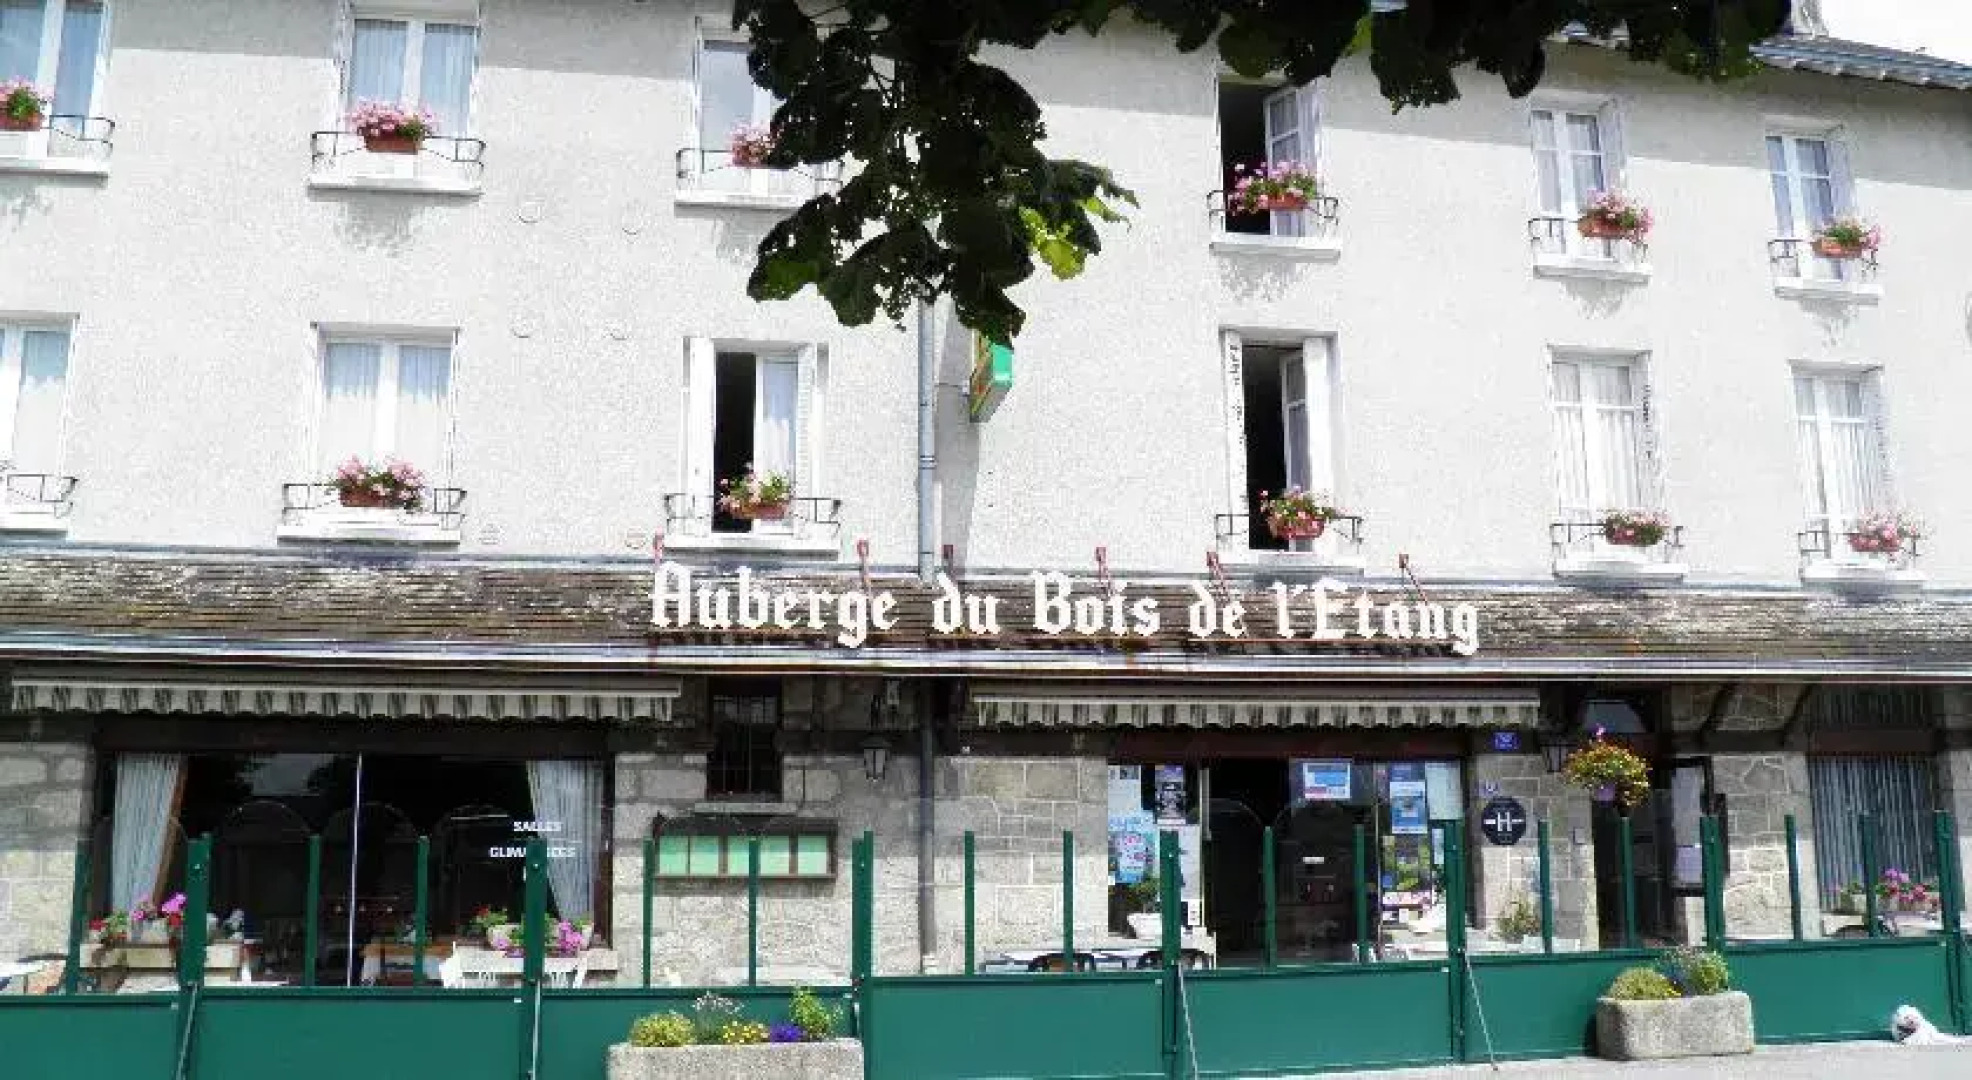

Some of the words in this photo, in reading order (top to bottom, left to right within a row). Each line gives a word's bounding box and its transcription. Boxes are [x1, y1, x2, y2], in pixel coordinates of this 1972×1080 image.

[648, 561, 899, 648] Auberge
[931, 571, 1002, 636] du
[1031, 570, 1160, 636] Bois
[1188, 579, 1247, 638] de
[513, 821, 562, 832] SALLES
